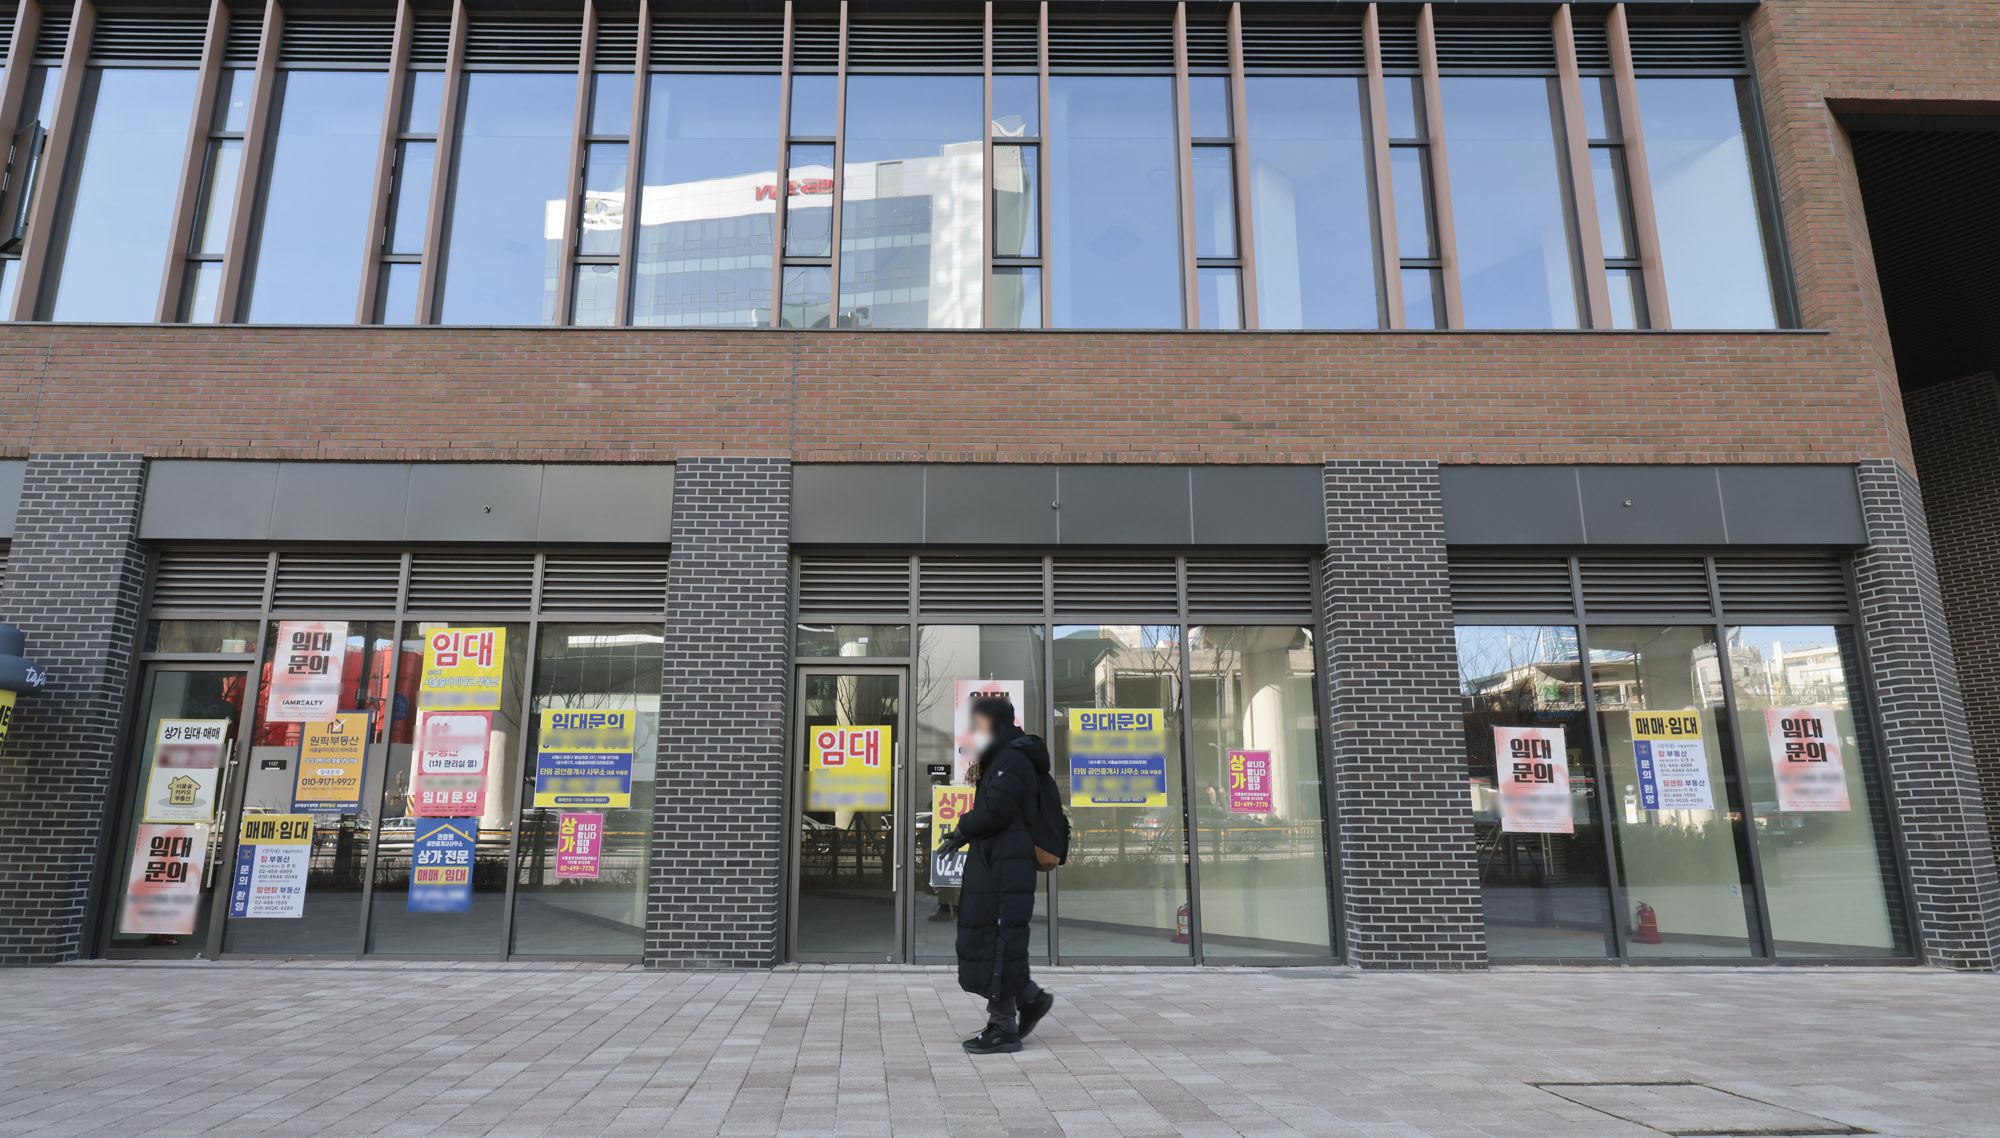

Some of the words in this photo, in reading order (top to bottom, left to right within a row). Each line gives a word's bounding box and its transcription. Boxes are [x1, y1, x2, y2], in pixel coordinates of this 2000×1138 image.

[292, 632, 332, 651] 임대
[432, 631, 494, 667] 임대
[288, 655, 330, 675] 문의
[476, 676, 500, 687] 부동산
[552, 713, 624, 729] 임대문의
[1080, 713, 1153, 731] 임대문의
[1781, 718, 1823, 738] 임대
[165, 726, 181, 739] 상가
[310, 736, 359, 747] 원픽부동산
[817, 729, 879, 766] 임대
[1510, 738, 1552, 759] 임대
[1785, 742, 1828, 762] 문의
[428, 760, 442, 768] (1차
[444, 760, 465, 768] 관리실
[1230, 754, 1246, 789] 상가
[1512, 762, 1554, 784] 문의
[1641, 760, 1651, 779] 문의
[301, 778, 357, 786] 010-9171-9927
[422, 791, 478, 804] 임대문의
[1644, 784, 1655, 804] 환영
[560, 817, 578, 853] 상가
[149, 836, 193, 857] 임대
[417, 850, 443, 864] 상가
[444, 850, 469, 864] 전문
[144, 862, 188, 883] 문의
[238, 865, 249, 886] 문의
[235, 890, 246, 911] 환영
